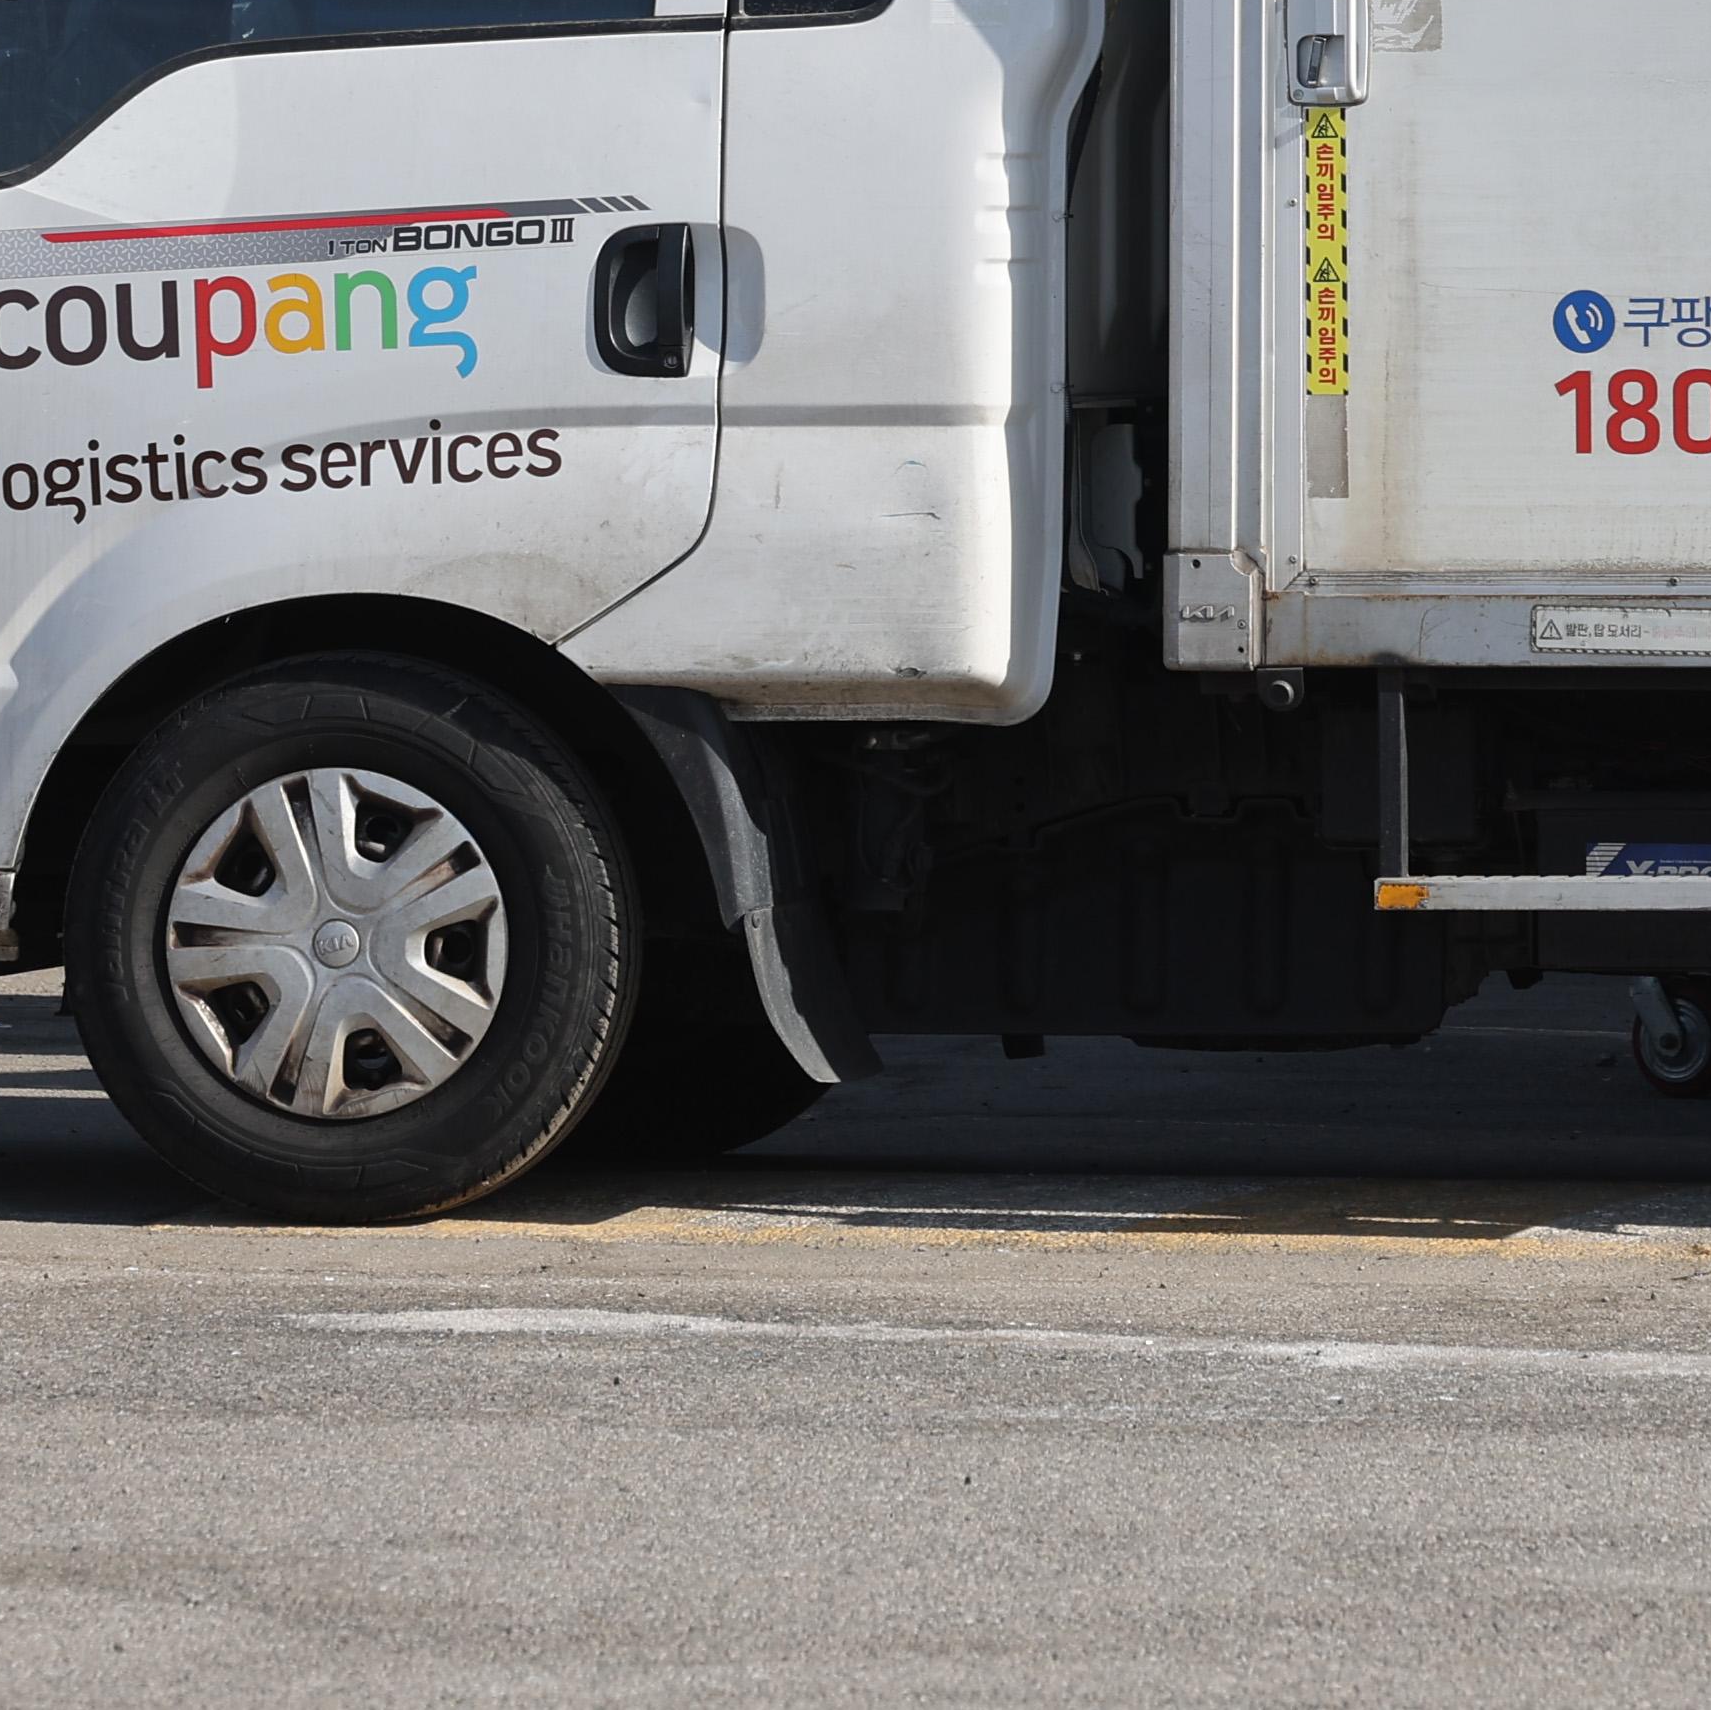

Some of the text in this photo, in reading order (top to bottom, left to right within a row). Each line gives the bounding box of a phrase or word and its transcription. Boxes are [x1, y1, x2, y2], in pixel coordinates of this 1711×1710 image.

[340, 237, 388, 255] TON
[392, 219, 545, 253] BONGO
[280, 418, 562, 493] services
[316, 933, 354, 957] KIA
